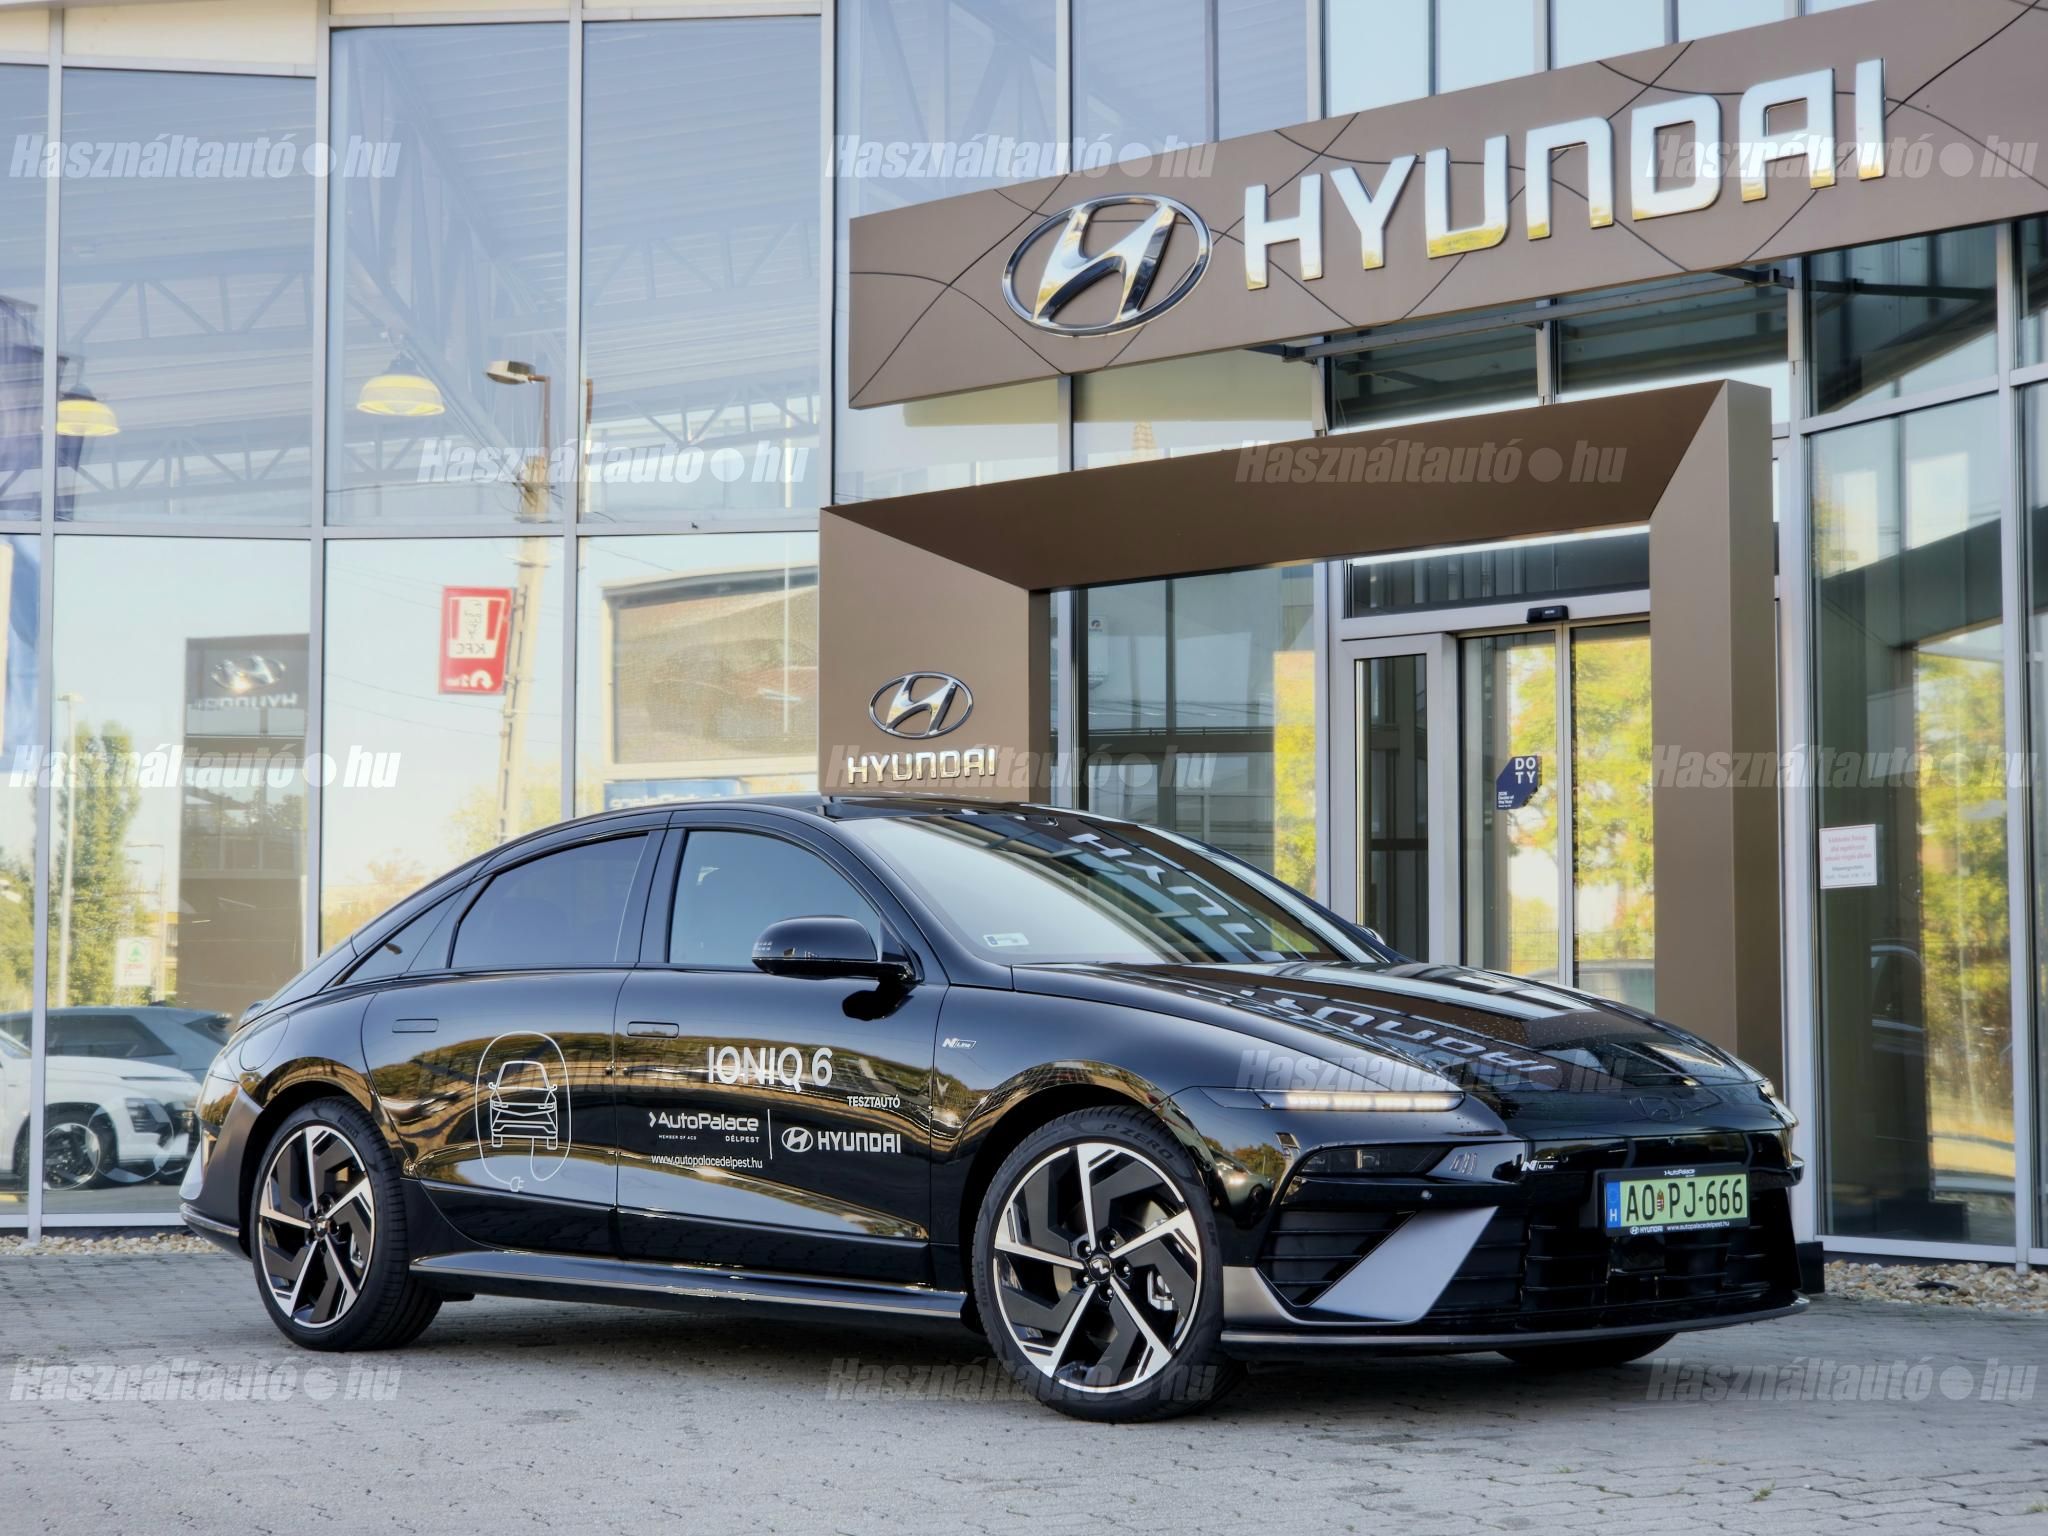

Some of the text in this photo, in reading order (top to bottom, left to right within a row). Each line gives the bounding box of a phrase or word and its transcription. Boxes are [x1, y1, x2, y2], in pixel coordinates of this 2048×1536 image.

[1244, 58, 1886, 290] HYUNDAI
[847, 748, 996, 784] HYUNDAI
[1514, 756, 1536, 770] DO
[1514, 770, 1536, 784] TY
[708, 1046, 801, 1093] IONIQ
[811, 1047, 833, 1087] 6
[847, 1094, 901, 1109] TESZTAUTÓ
[657, 1111, 760, 1132] AutoPalace
[725, 1134, 760, 1143] DÉLPEST
[817, 1130, 901, 1154] HYUNDAI
[1119, 1127, 1175, 1159] ZERO
[651, 1154, 763, 1169] www.autopalacedelpest.hu
[1626, 1178, 1743, 1222] AO PJ-666
[1609, 1208, 1618, 1222] H
